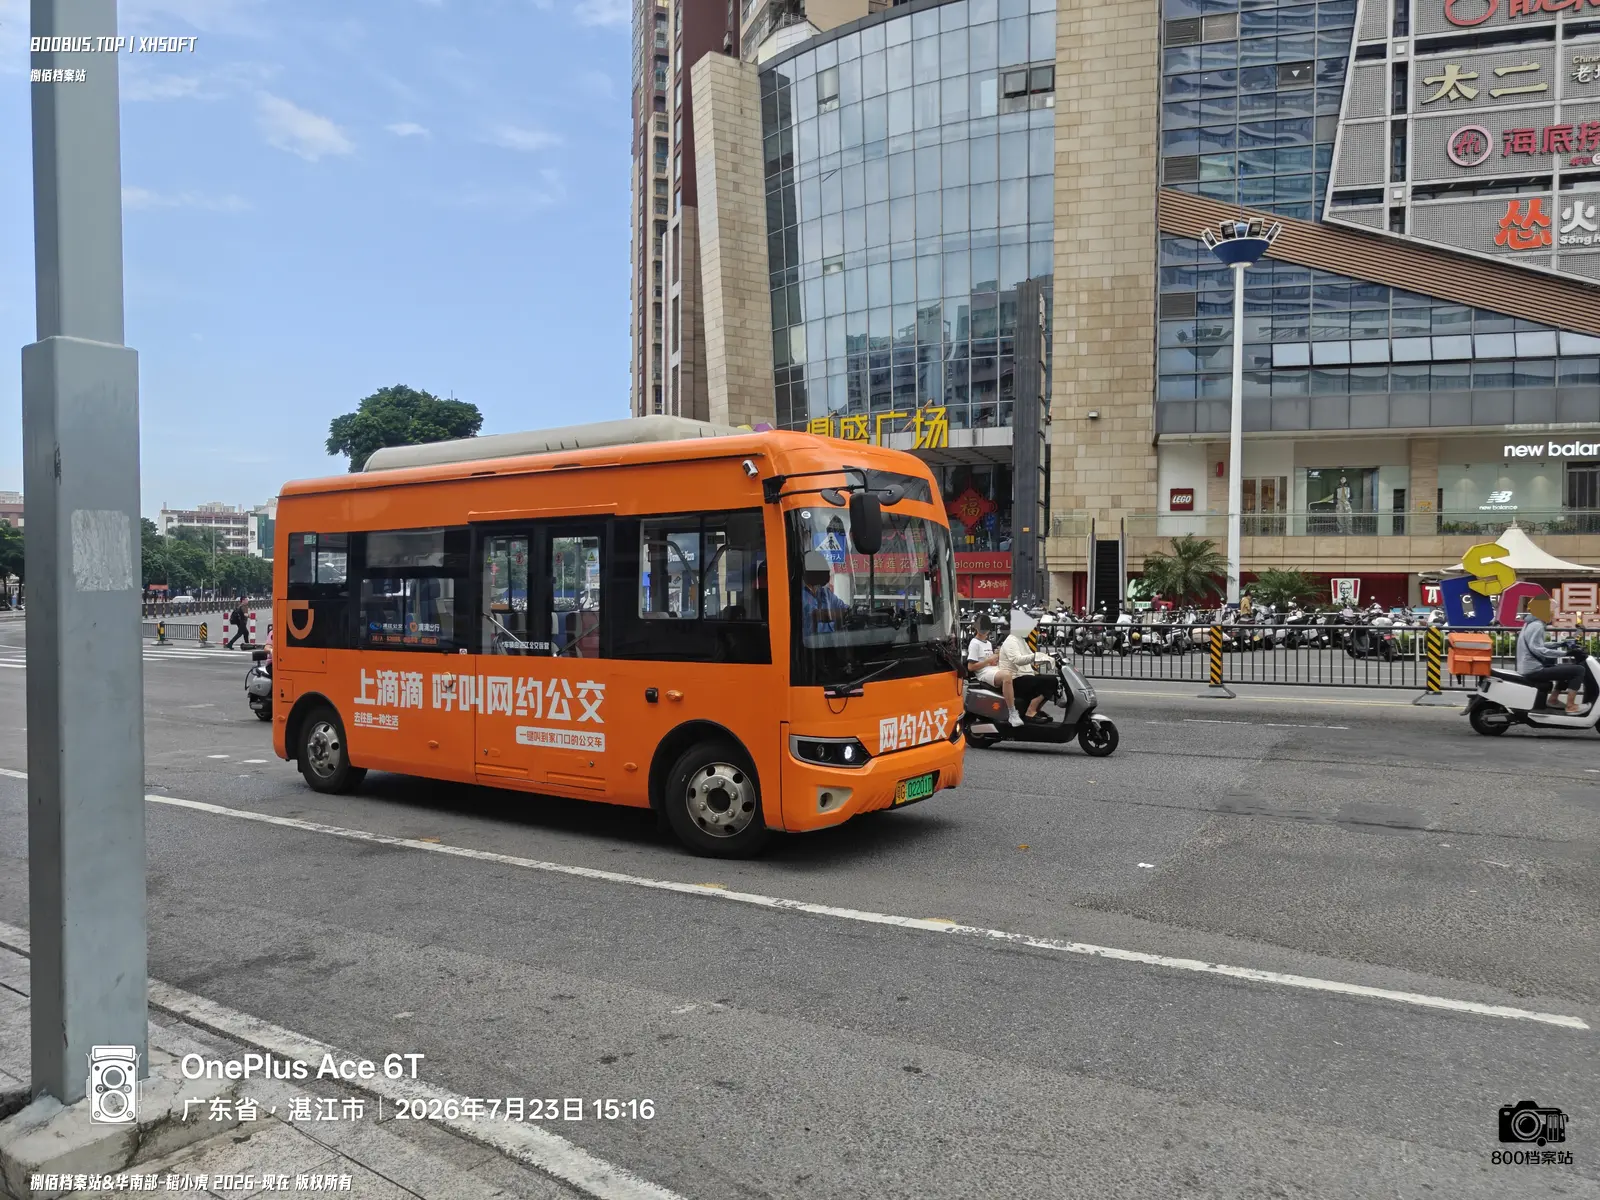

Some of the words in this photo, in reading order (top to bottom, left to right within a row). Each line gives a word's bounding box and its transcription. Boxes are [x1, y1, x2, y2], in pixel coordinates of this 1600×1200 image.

[1421, 62, 1548, 104] 太二
[1504, 444, 1544, 457] new
[960, 497, 981, 516] 福
[1172, 494, 1193, 504] LEGO
[954, 559, 989, 569] elcome
[993, 560, 1003, 569] to
[353, 668, 424, 709] 上滴滴
[432, 673, 606, 724] 呼叫网约公交
[519, 730, 603, 748] 一键叫到家门口的公交车
[879, 708, 948, 753] 网约公交
